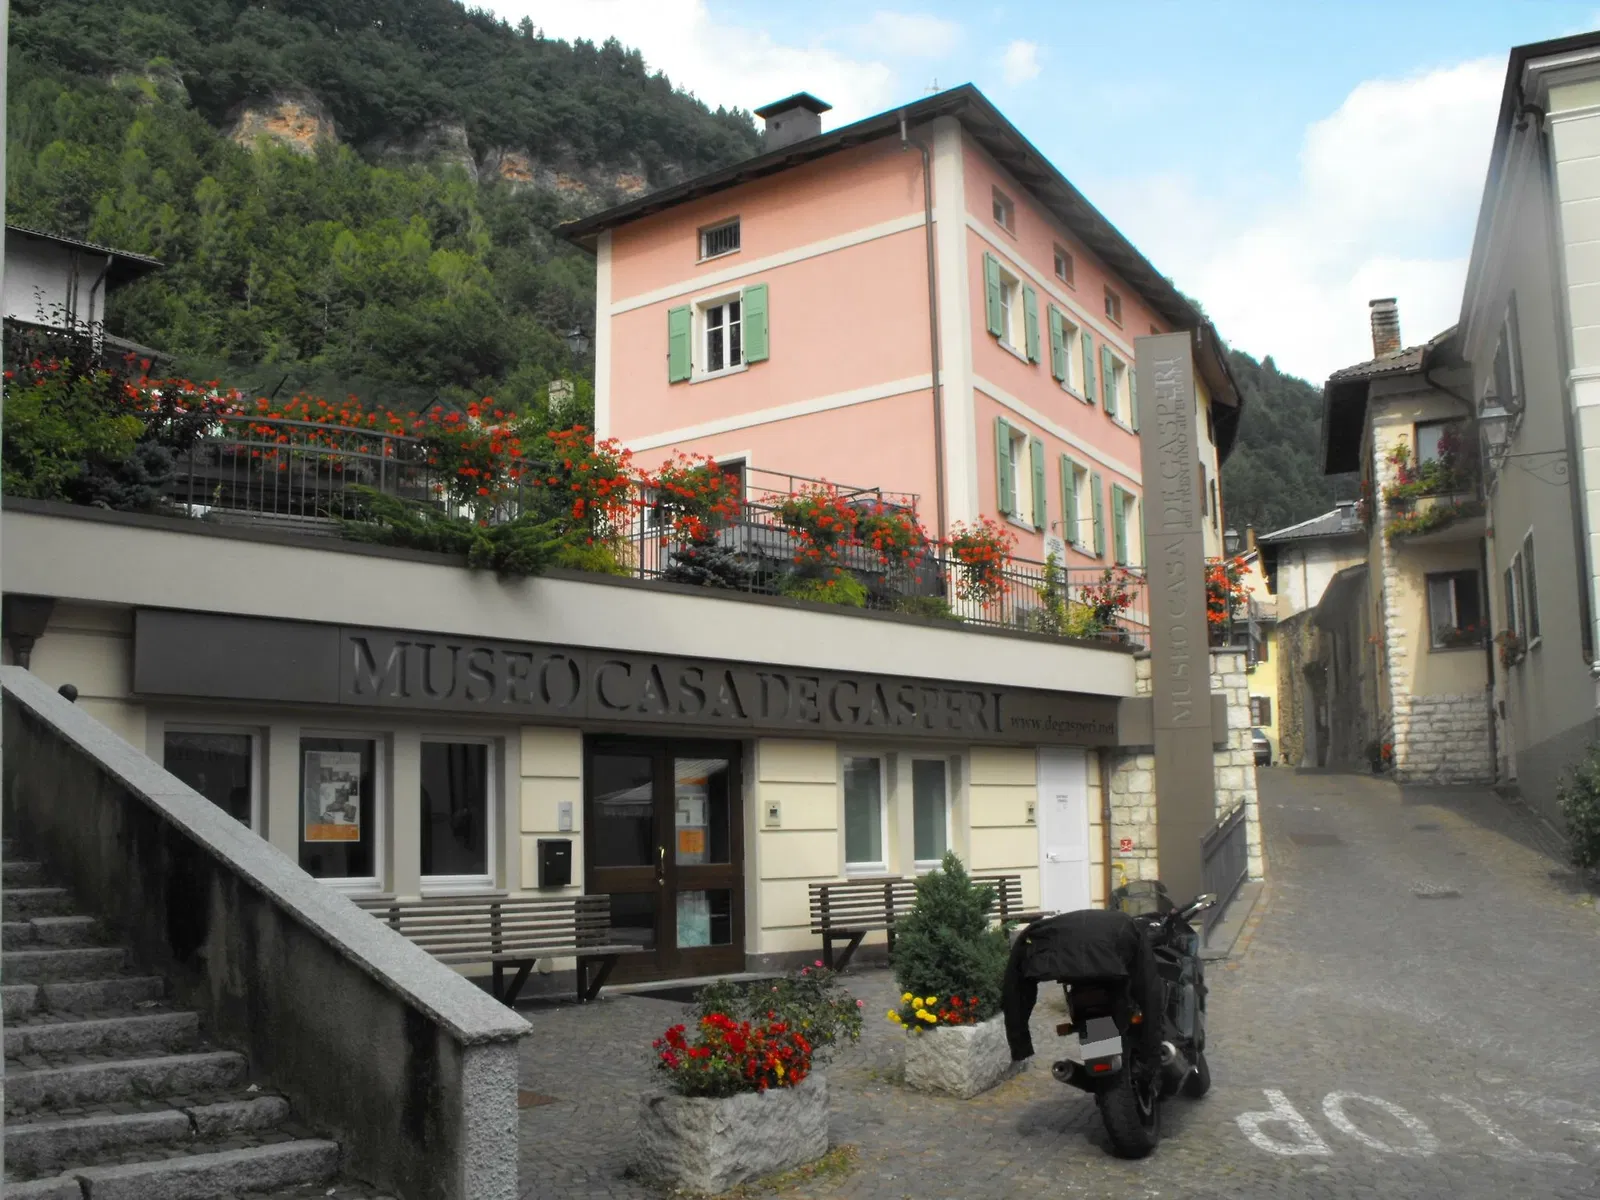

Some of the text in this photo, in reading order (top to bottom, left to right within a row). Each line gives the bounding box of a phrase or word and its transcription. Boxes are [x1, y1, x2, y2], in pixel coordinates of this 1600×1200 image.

[1164, 538, 1188, 619] CASA
[349, 637, 580, 708] MUSEO
[595, 660, 747, 719] CASA
[1168, 624, 1192, 722] MUSEO
[1009, 714, 1116, 738] www.degasperi.net
